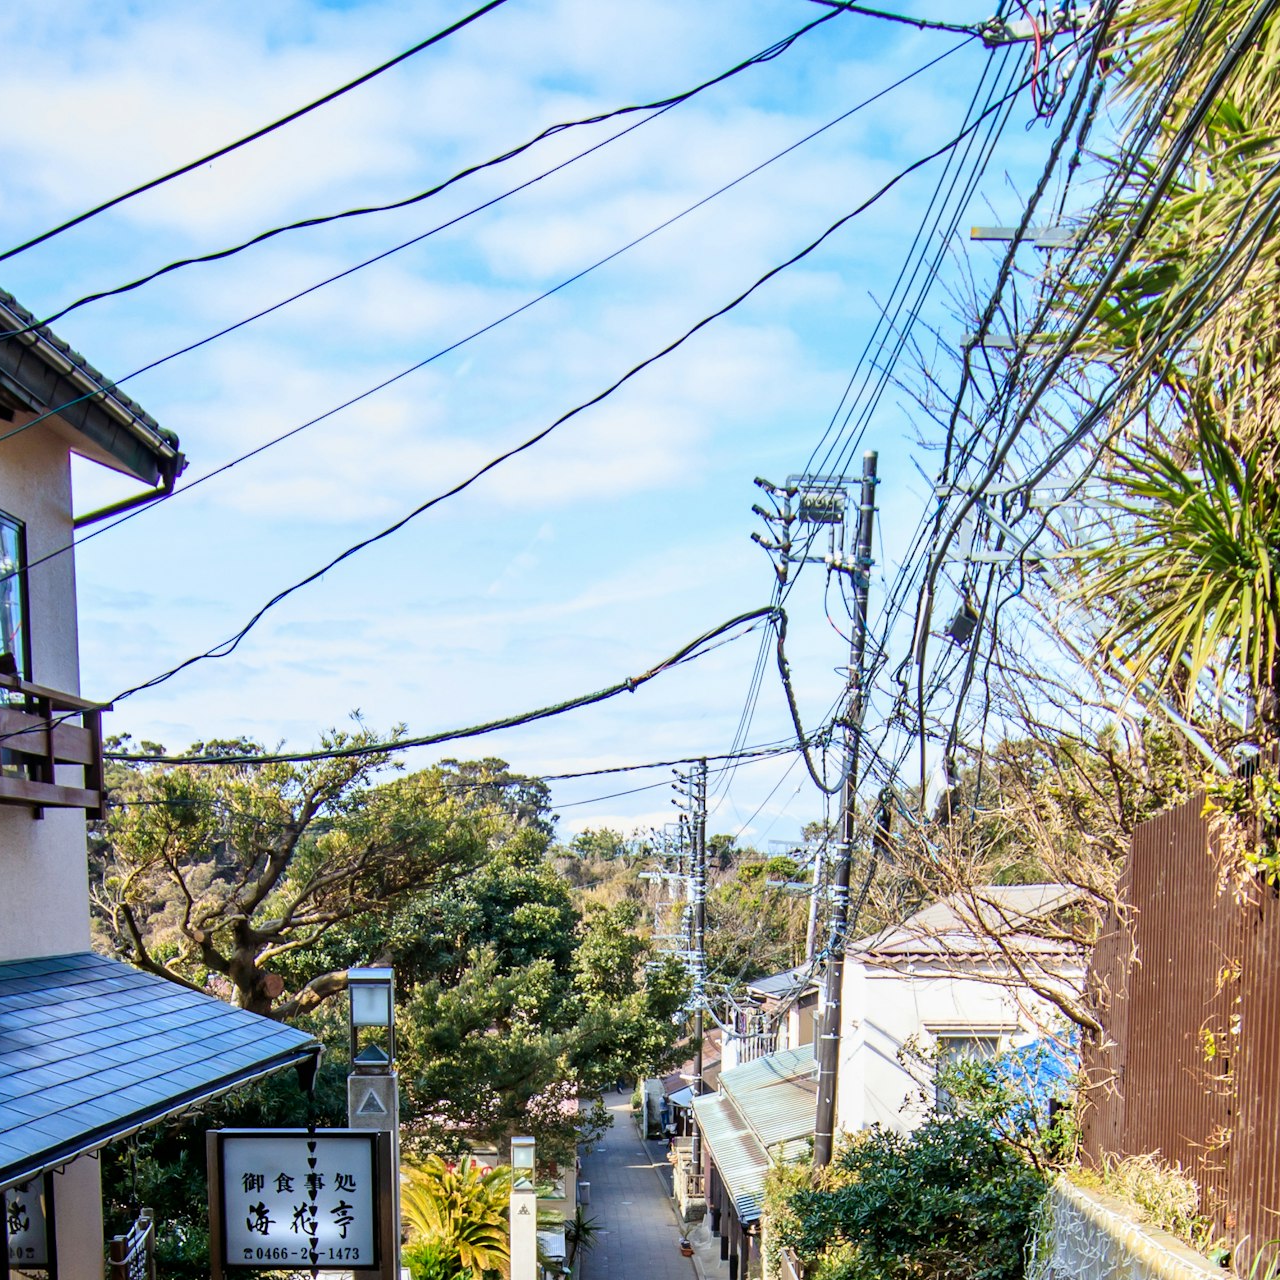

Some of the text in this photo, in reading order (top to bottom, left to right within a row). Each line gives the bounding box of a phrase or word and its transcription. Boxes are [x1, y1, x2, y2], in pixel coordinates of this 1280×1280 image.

[241, 1171, 357, 1194] 御食事処
[246, 1199, 356, 1239] 海花亭
